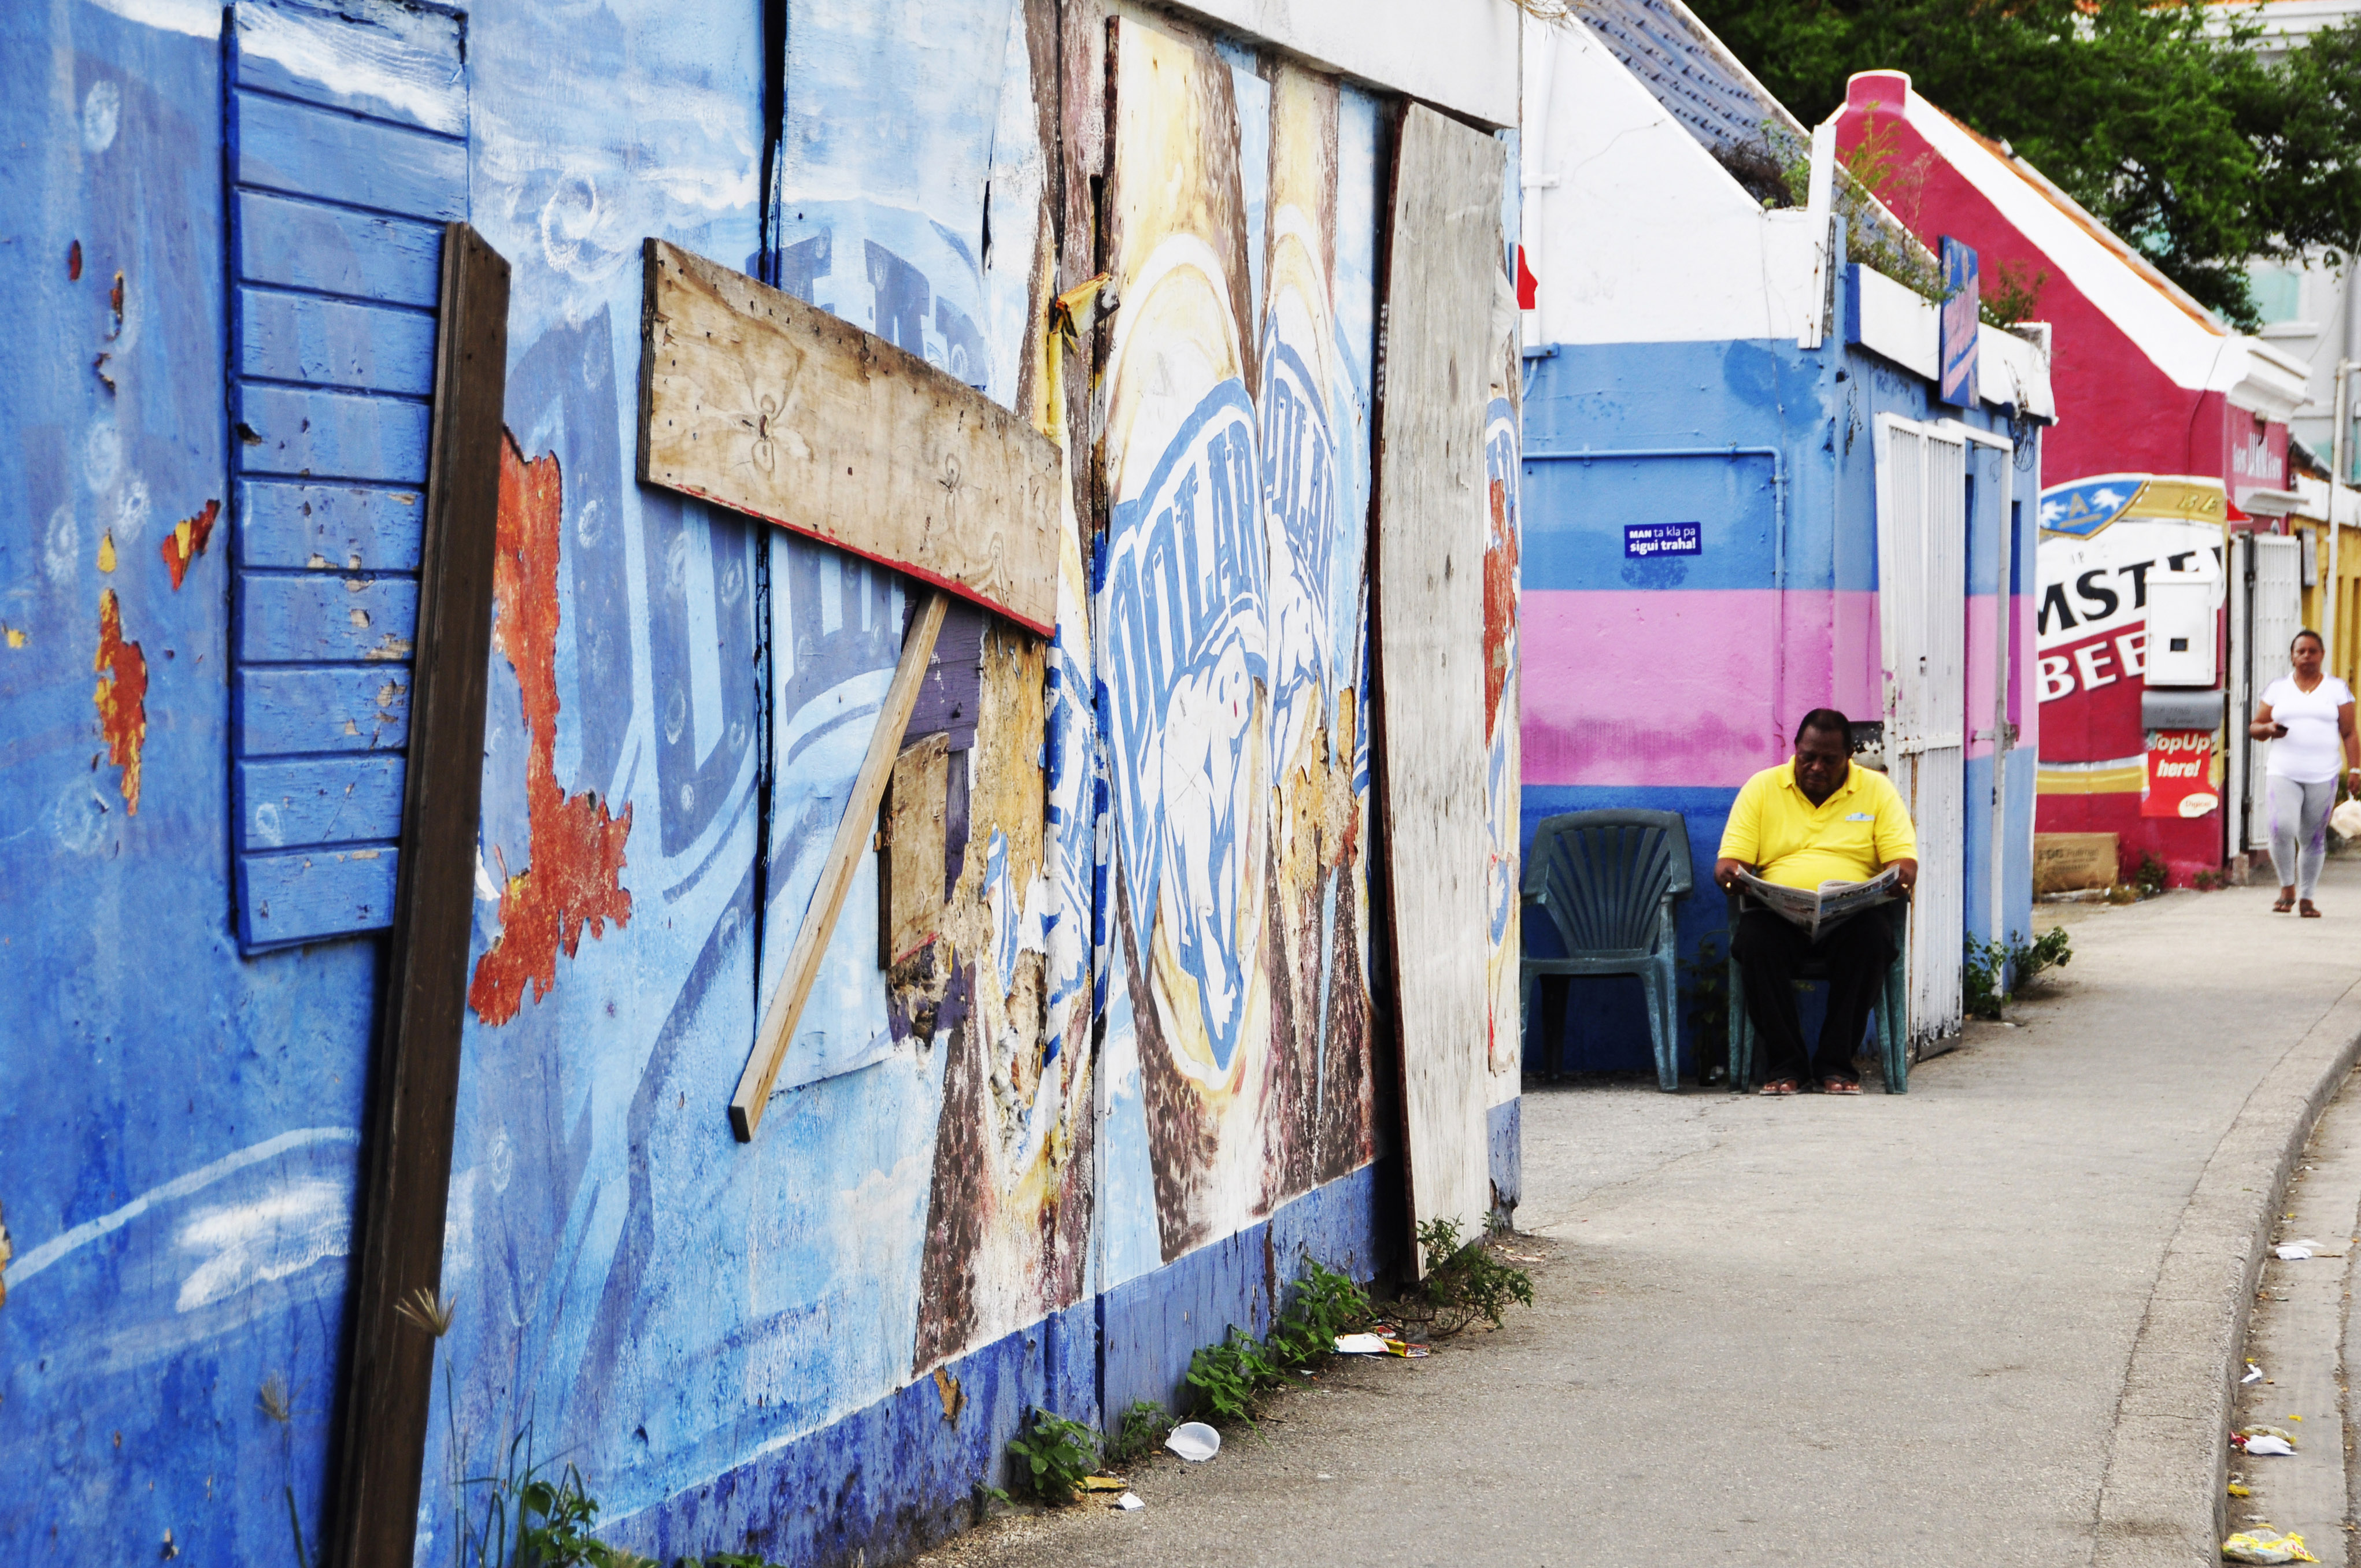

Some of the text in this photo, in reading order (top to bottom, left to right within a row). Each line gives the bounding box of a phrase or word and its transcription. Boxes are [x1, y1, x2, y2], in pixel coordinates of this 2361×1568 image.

[1629, 525, 1696, 539] MAN ta kla pa
[1630, 537, 1696, 555] sigui traha!
[2153, 733, 2211, 754] TopUp
[2156, 758, 2201, 778] here!
